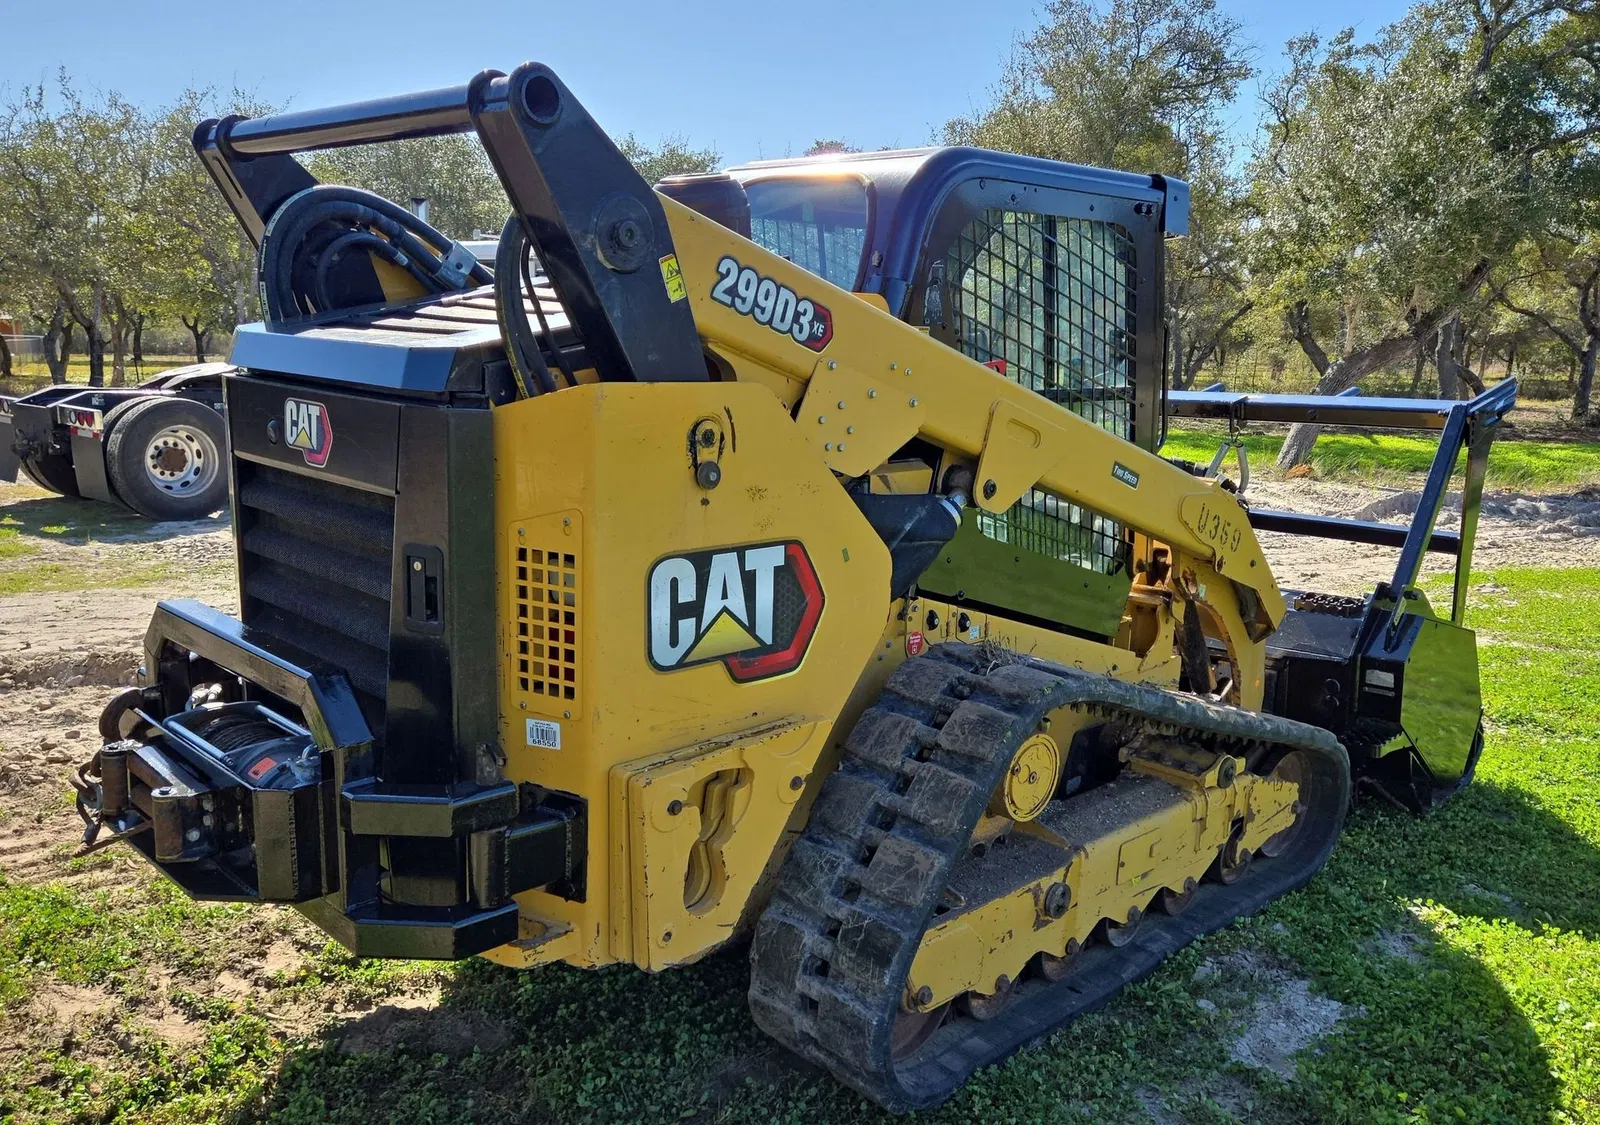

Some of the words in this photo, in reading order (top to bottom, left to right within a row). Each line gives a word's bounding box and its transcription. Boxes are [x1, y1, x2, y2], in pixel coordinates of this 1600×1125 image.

[712, 258, 814, 341] 299D3
[811, 320, 825, 337] XE
[286, 400, 320, 450] CAT
[651, 545, 785, 667] CAT
